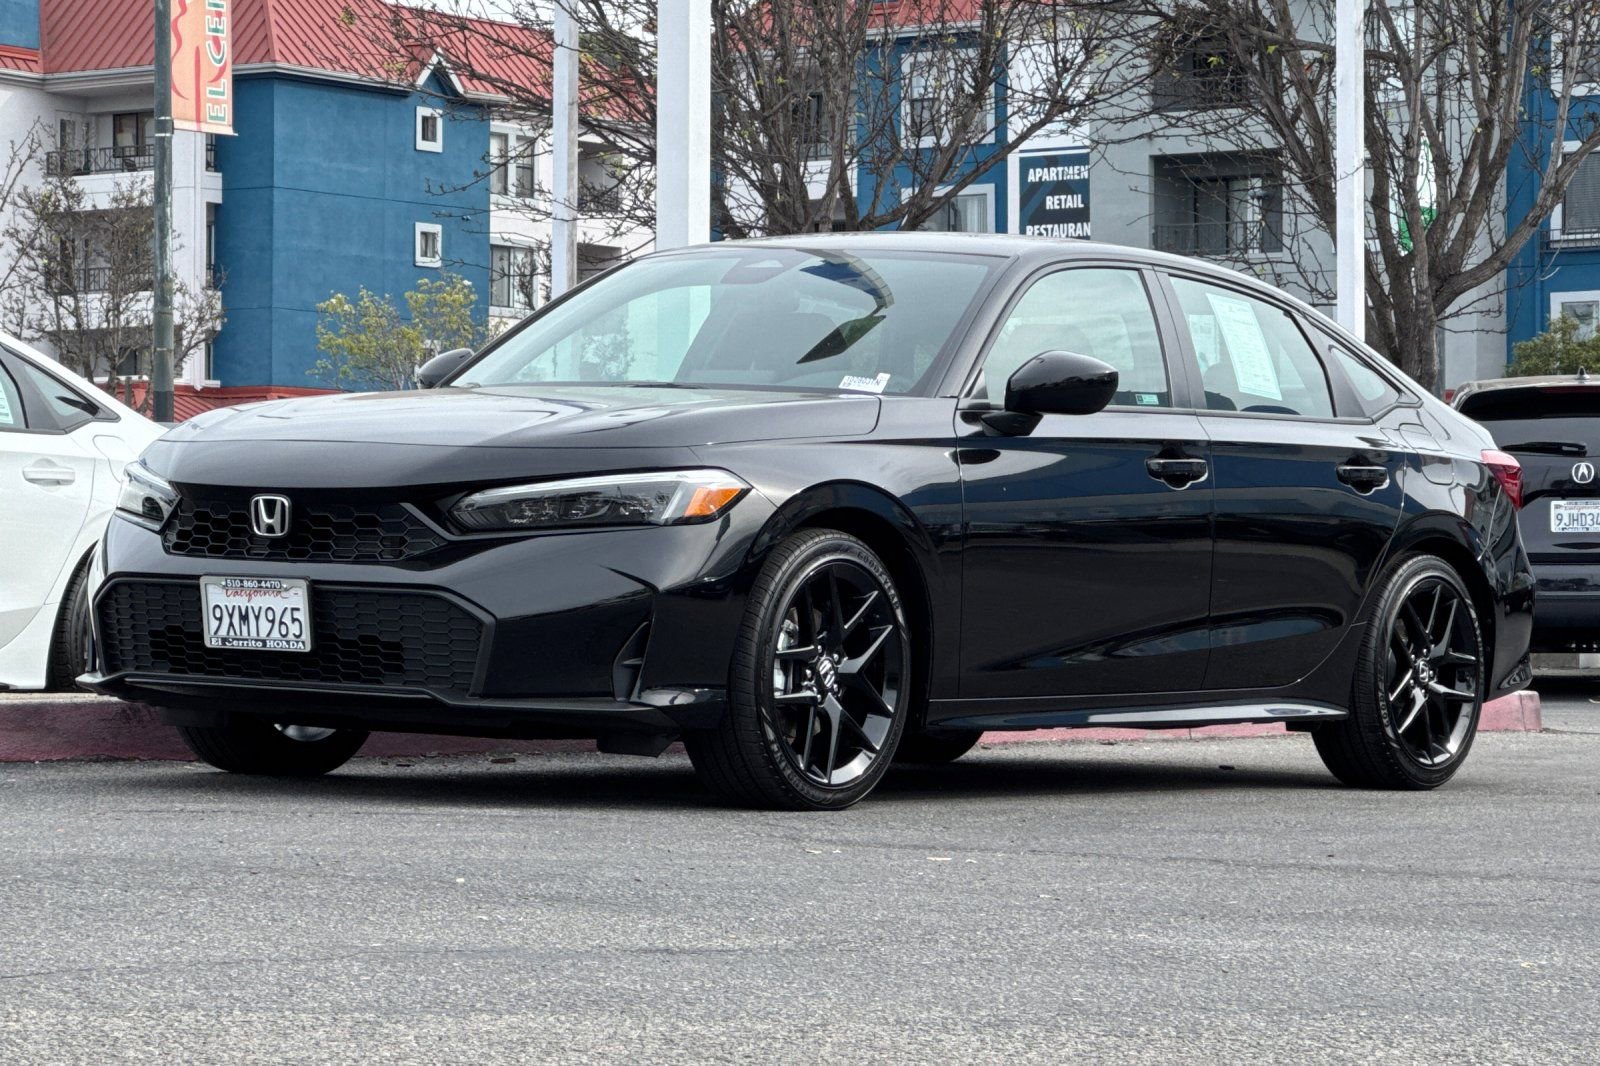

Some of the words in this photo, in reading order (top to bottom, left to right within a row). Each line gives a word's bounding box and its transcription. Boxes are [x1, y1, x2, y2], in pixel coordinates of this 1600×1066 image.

[206, 79, 228, 124] EL
[1045, 194, 1084, 210] RETAIL
[227, 579, 280, 588] 510-860-4470
[212, 604, 302, 639] 9XMY965
[211, 637, 222, 646] El
[266, 640, 304, 650] HONDA
